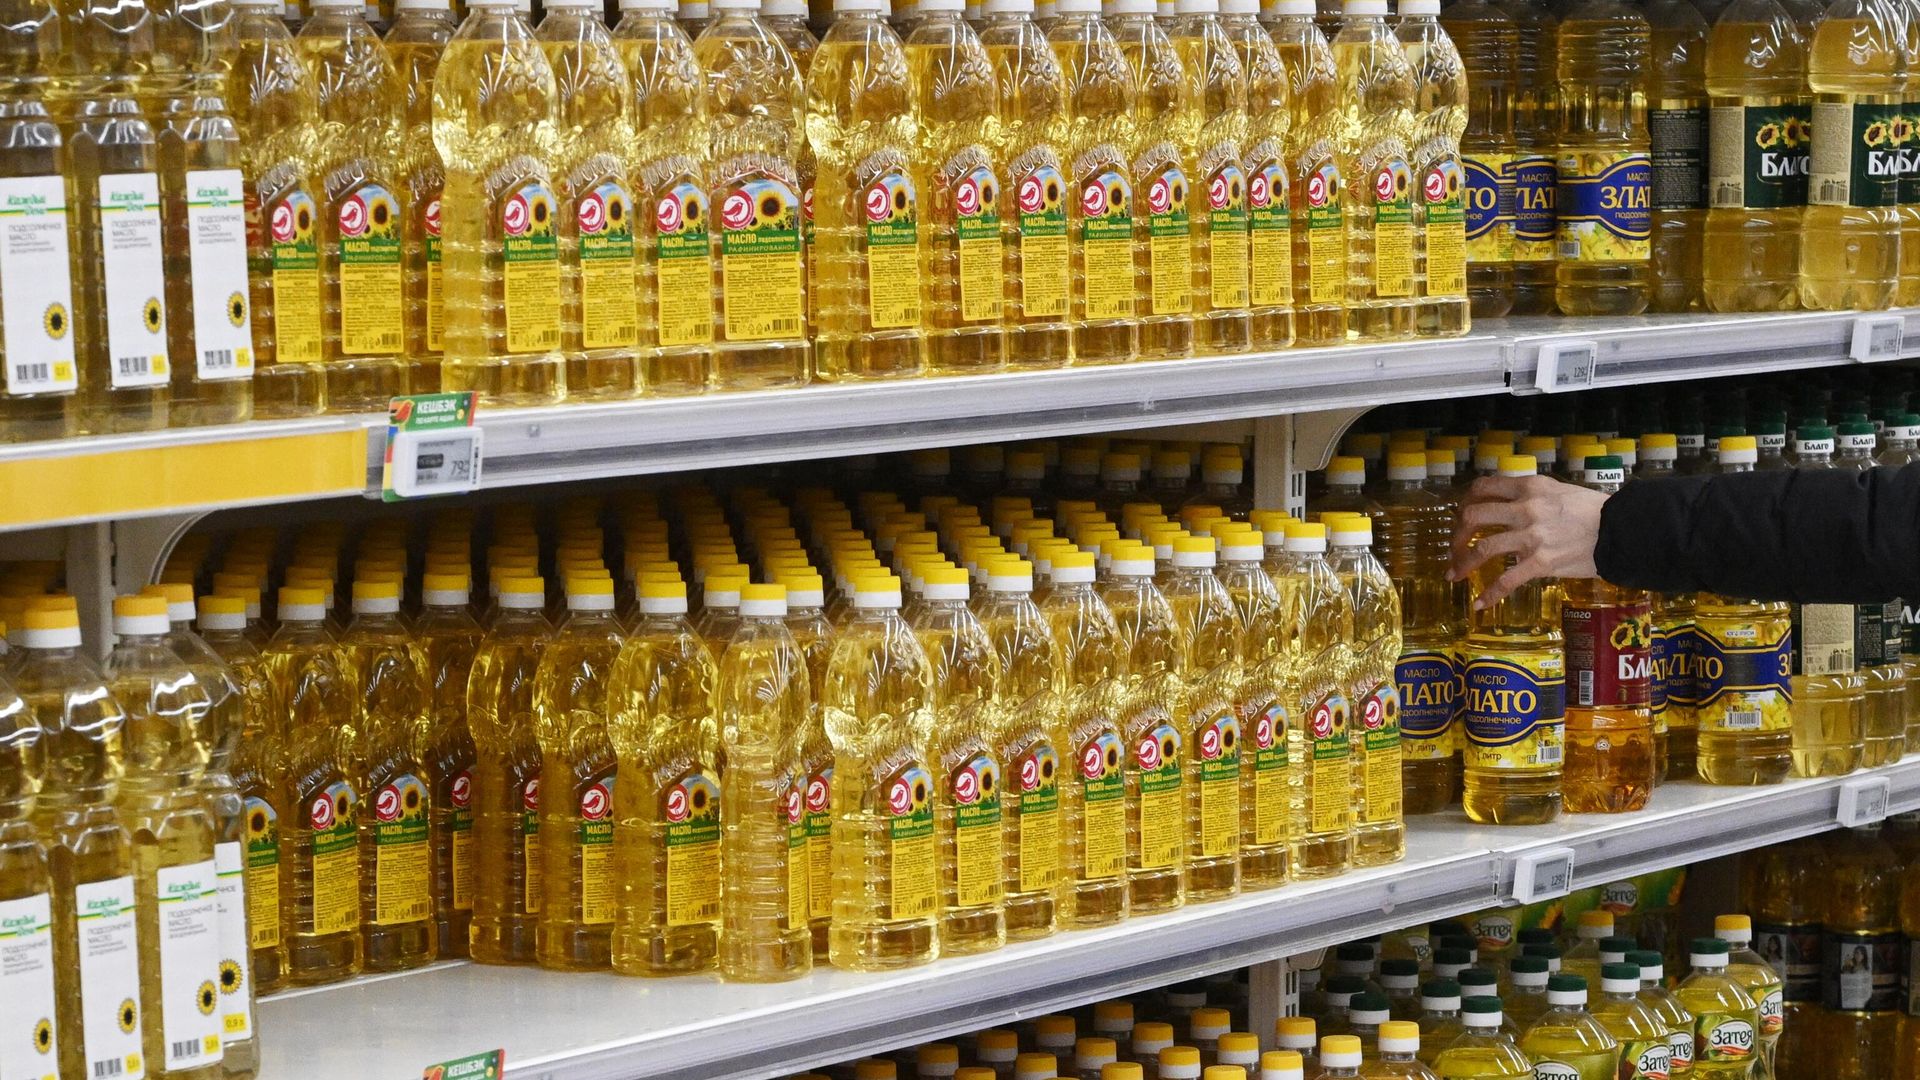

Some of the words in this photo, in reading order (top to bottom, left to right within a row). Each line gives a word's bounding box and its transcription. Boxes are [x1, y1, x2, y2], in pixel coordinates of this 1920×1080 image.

[1312, 210, 1328, 220] МАСЛО
[1379, 205, 1396, 214] МАСЛО
[1429, 205, 1447, 215] МАСЛО
[1024, 216, 1045, 227] МАСЛО
[1153, 217, 1172, 227] МАСЛО
[1213, 213, 1229, 222] МАСЛО
[1254, 212, 1271, 221] МАСЛО
[962, 218, 982, 229] МАСЛО
[1088, 220, 1109, 230] МАСЛО
[871, 225, 892, 235] МАСЛО
[585, 238, 607, 248] МАСЛО
[662, 237, 684, 247] МАСЛО
[728, 233, 757, 244] МАСЛО
[345, 242, 369, 252] МАСЛО
[508, 240, 531, 250] МАСЛО
[417, 399, 456, 414] КЕШБЭК
[1404, 667, 1440, 679] МАСЛО
[1473, 674, 1508, 687] МАСЛО
[1399, 683, 1453, 706] ЛАТО
[1468, 688, 1537, 714] ЛАТО
[1417, 744, 1437, 755] литр
[1482, 752, 1502, 763] литр
[960, 808, 980, 817] МАСЛО
[587, 824, 611, 835] МАСЛО
[893, 819, 913, 829] МАСЛО
[381, 825, 402, 836] МАСЛО
[670, 825, 692, 835] МАСЛО
[1760, 1000, 1782, 1016] Зат
[1711, 1028, 1752, 1046] Затея
[1639, 1055, 1668, 1072] Зате
[1533, 1068, 1578, 1080] Затея
